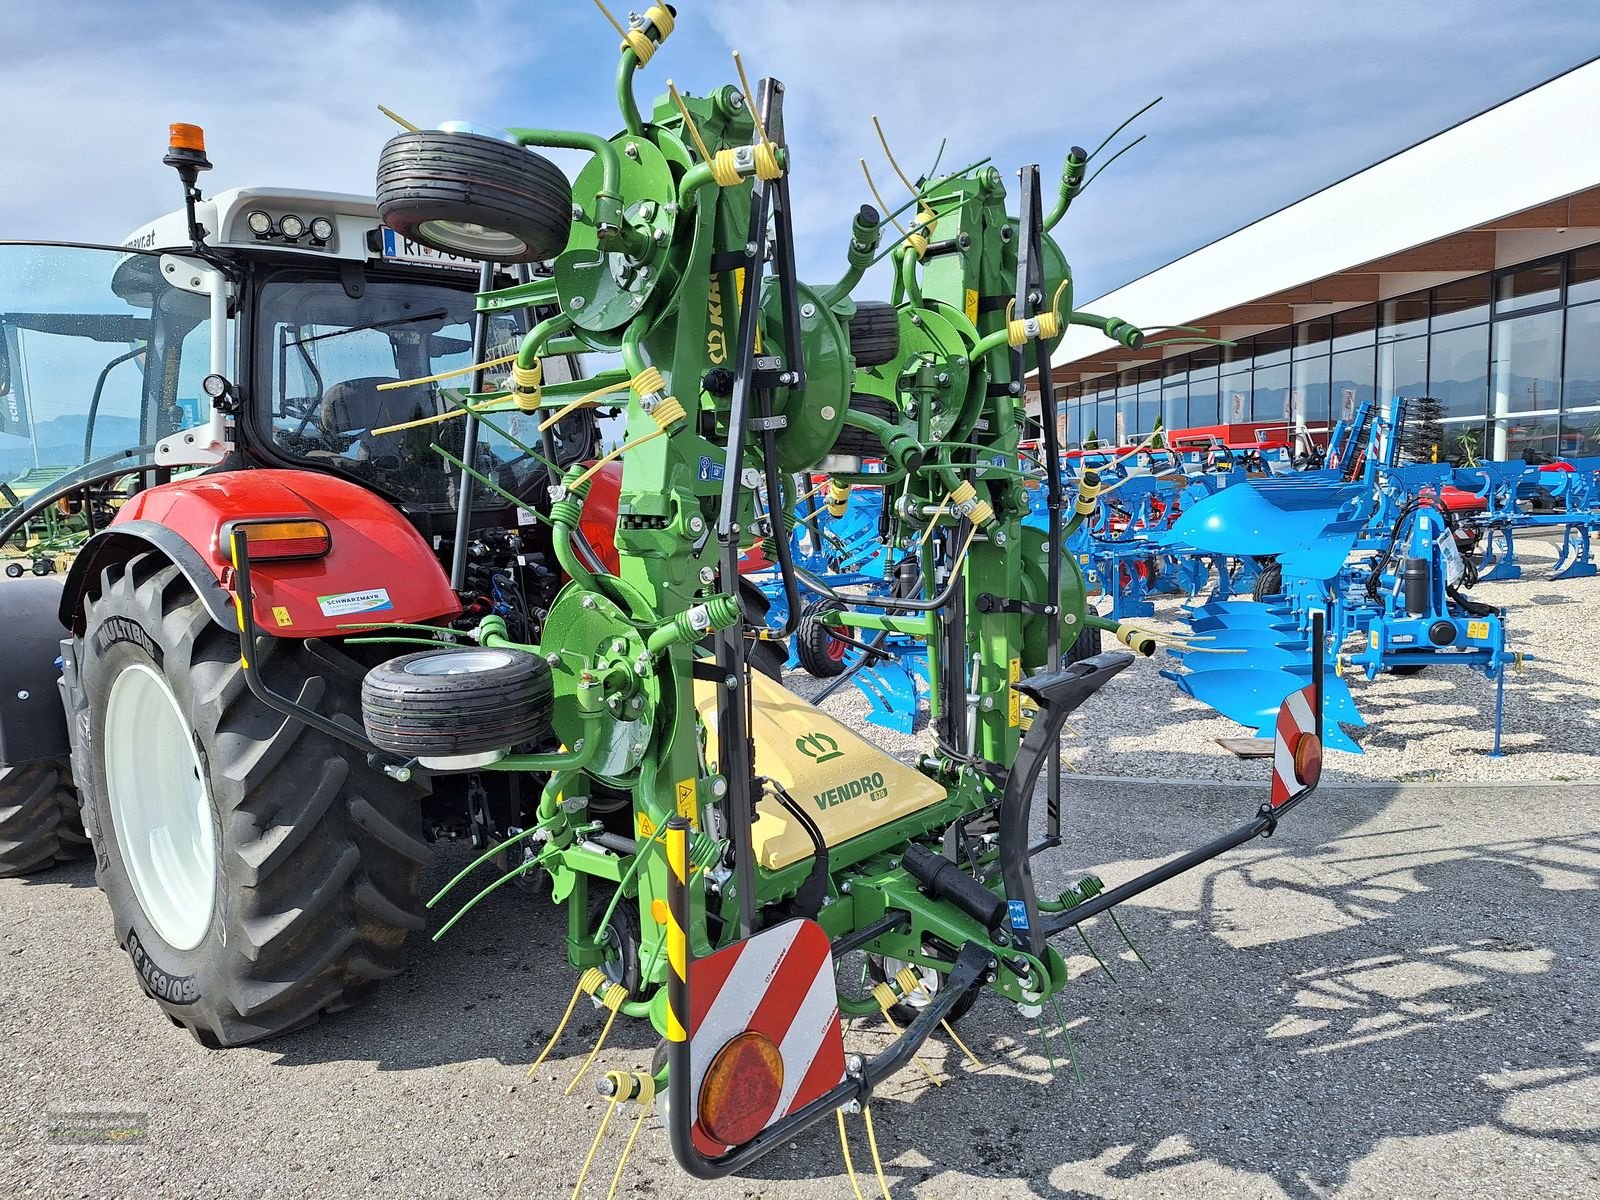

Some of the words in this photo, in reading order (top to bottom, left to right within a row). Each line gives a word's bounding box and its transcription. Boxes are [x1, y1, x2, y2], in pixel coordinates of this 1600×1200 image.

[327, 594, 379, 606] SCHWARZMAYR
[98, 619, 155, 659] MULTIBIB
[813, 771, 884, 811] VENDRO
[129, 935, 143, 968] 38
[142, 958, 152, 980] R
[150, 970, 198, 1002] 650/65
